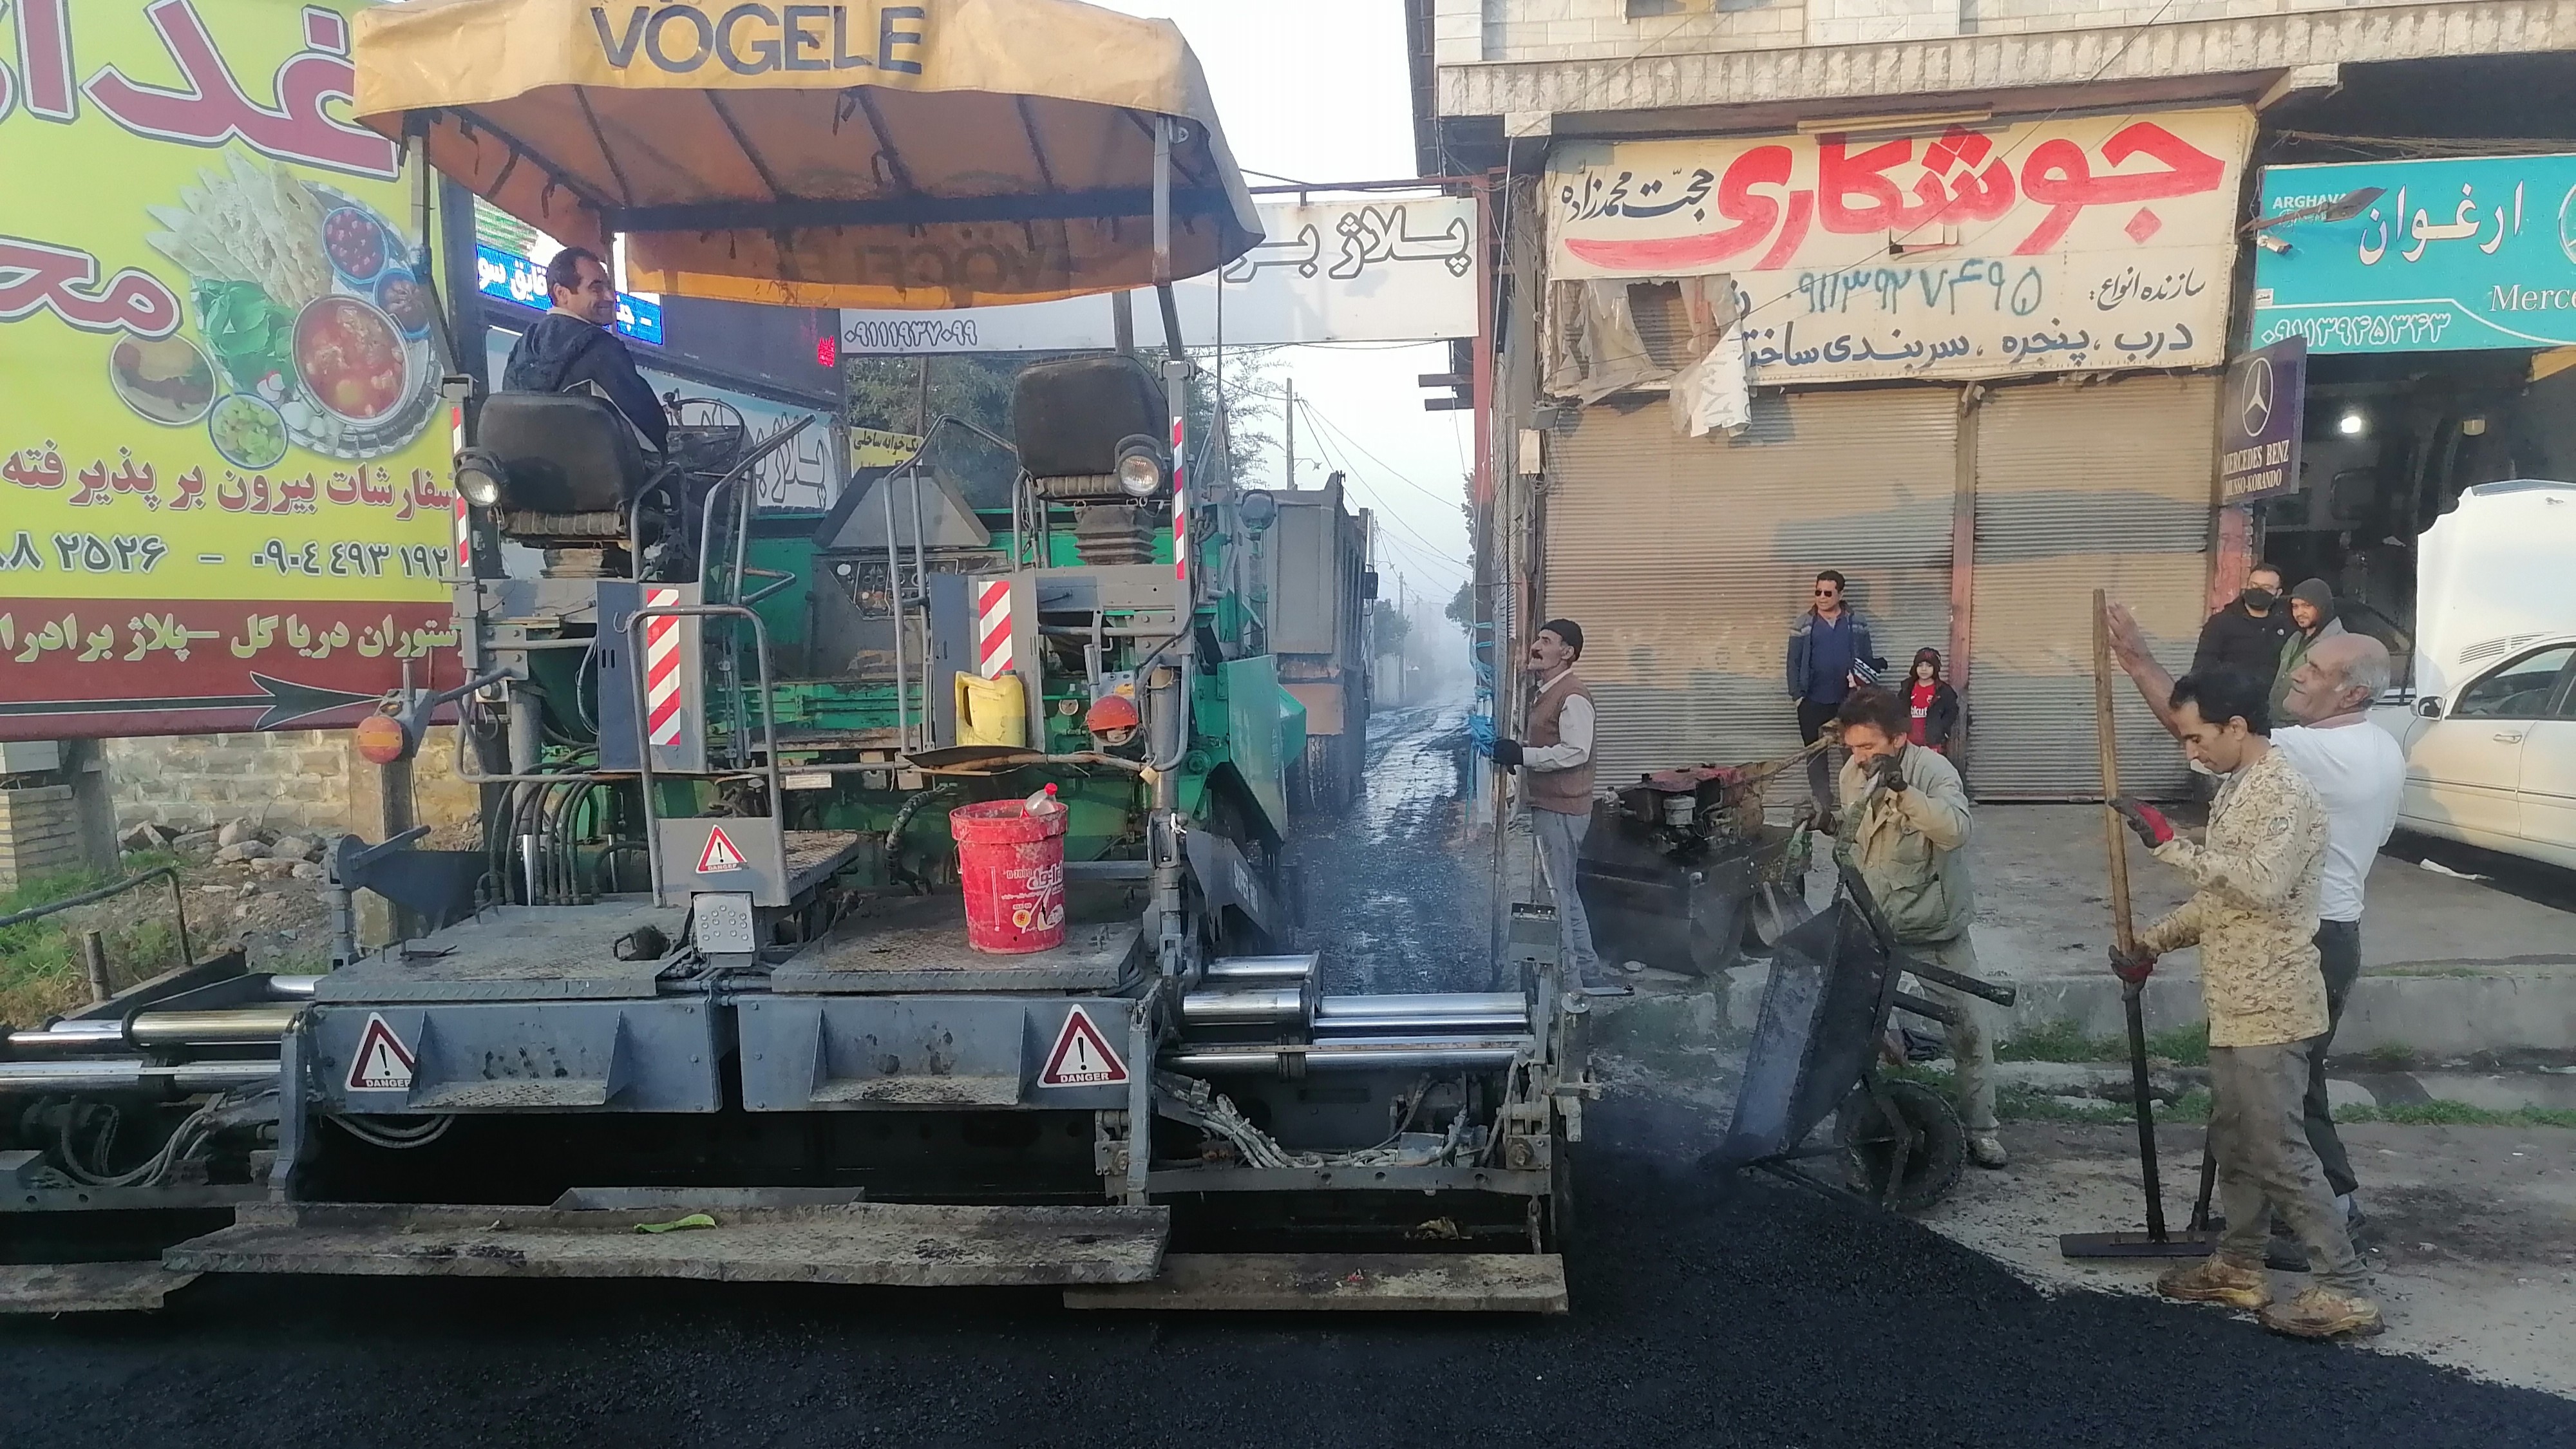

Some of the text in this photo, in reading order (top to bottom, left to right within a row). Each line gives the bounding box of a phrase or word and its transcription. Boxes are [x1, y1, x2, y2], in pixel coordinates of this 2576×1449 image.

[1564, 122, 2225, 270] جوشکاری
[1328, 205, 1472, 279] پلاژ
[2358, 179, 2524, 266] ارغوان
[2141, 267, 2206, 302] سازنده
[2488, 284, 2576, 312] Merc
[844, 319, 978, 347] ۰۹۱۱۱۹۳۷۰۹۹
[2114, 322, 2193, 363] درب
[2222, 439, 2290, 477] MERCEDES BENZ
[169, 464, 207, 511] بر
[217, 468, 318, 516] بیرون
[52, 532, 168, 573] ۲۵۲۶
[231, 612, 279, 659] گل
[289, 613, 351, 659] دریا
[1060, 1072, 1110, 1083] DANGER
